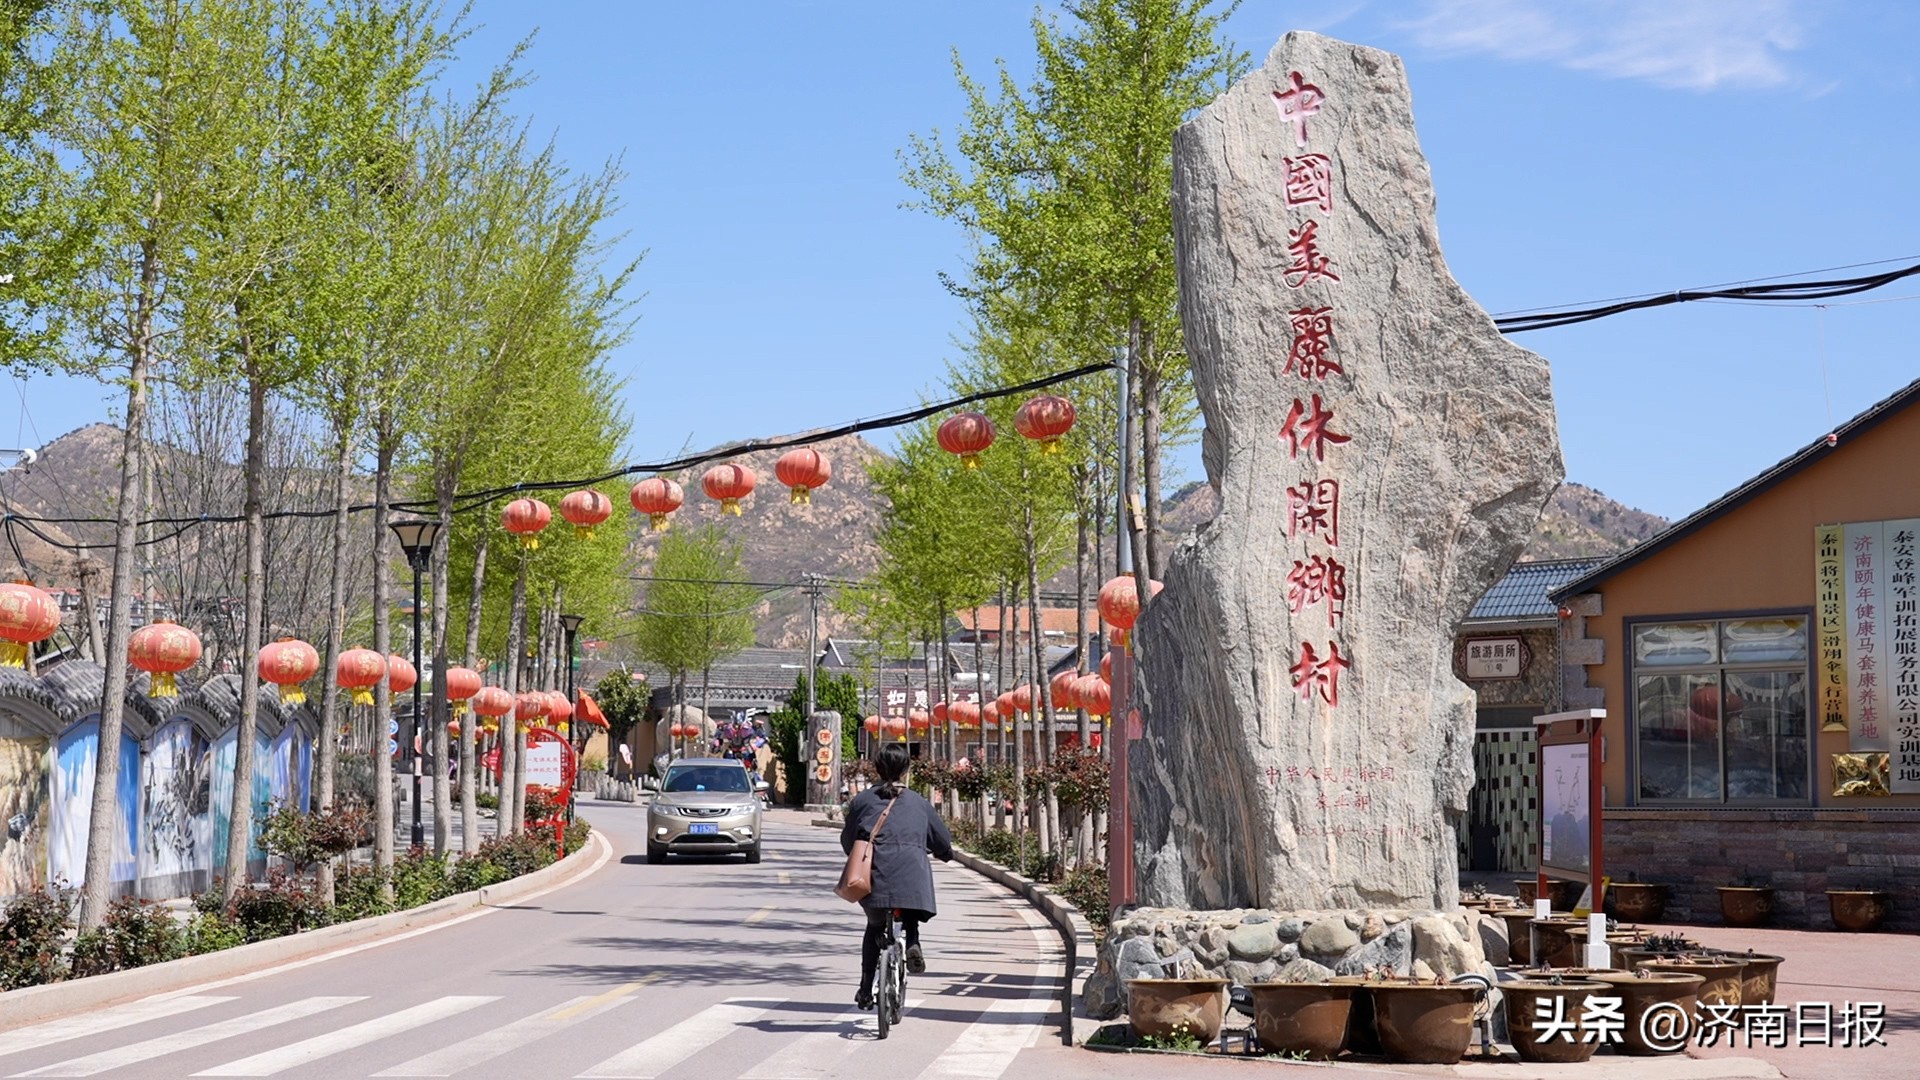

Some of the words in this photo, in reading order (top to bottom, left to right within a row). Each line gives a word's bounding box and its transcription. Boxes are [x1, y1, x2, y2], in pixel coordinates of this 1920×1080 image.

[1854, 535, 1879, 740] 济南颐年健康马套康养基地
[1471, 644, 1516, 658] 旅游厕所
[1265, 766, 1395, 785] 中华人民共和国
